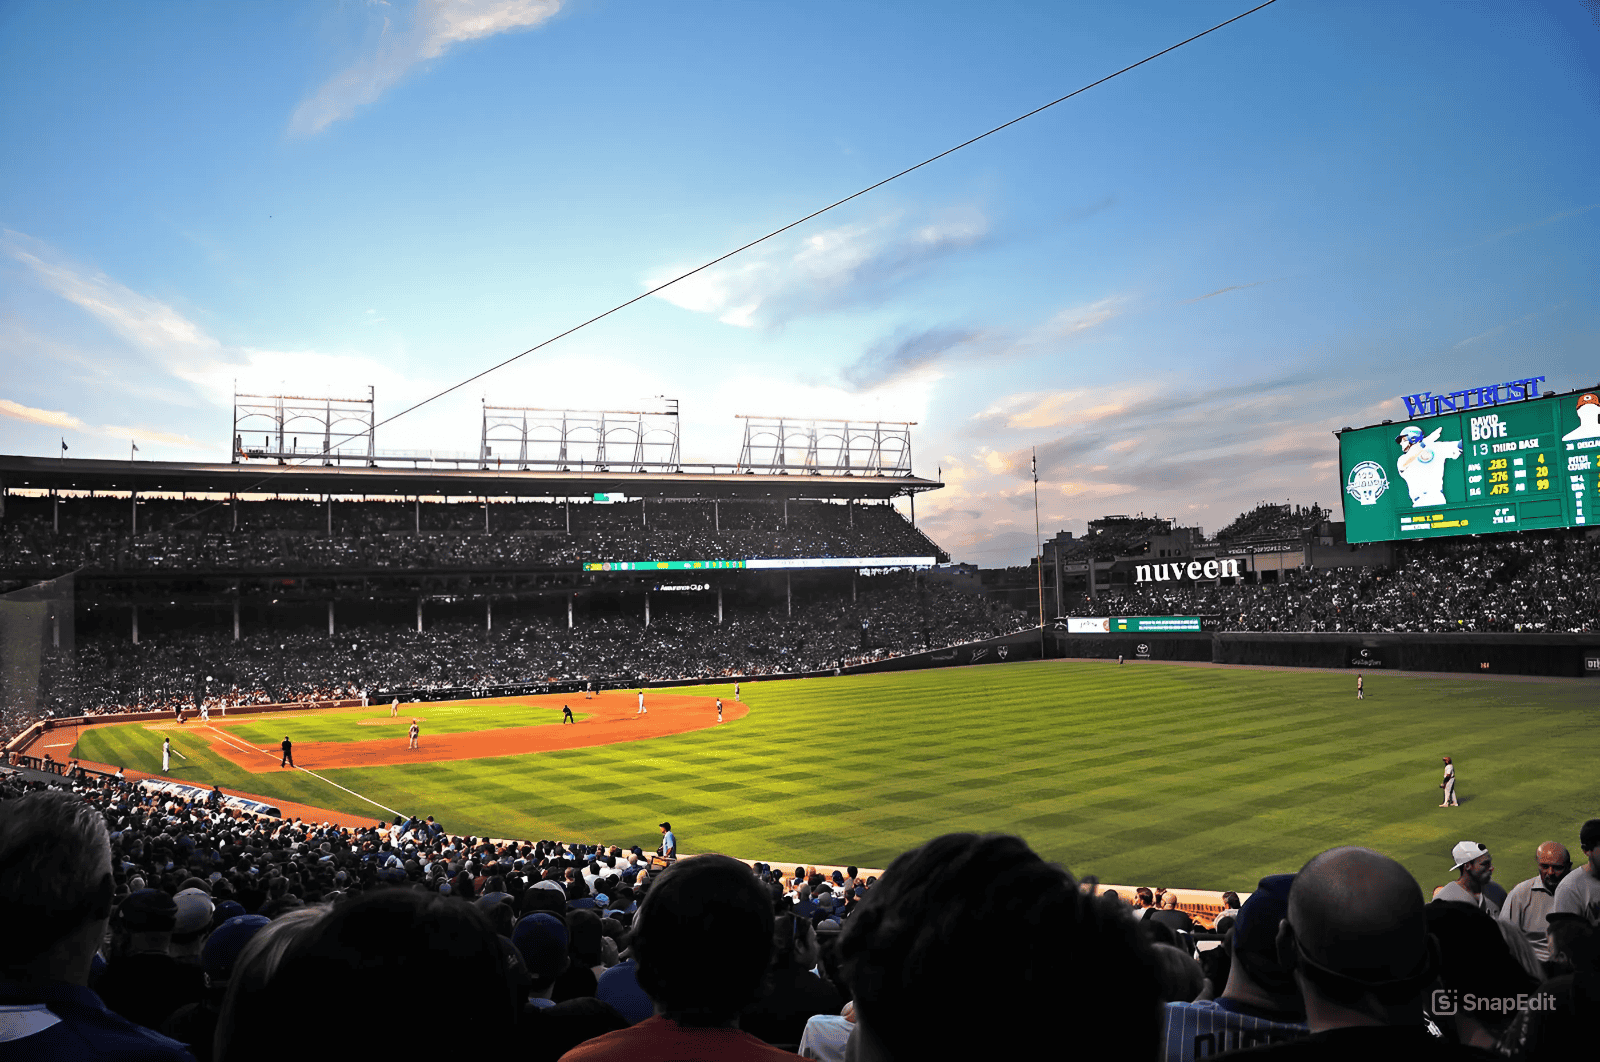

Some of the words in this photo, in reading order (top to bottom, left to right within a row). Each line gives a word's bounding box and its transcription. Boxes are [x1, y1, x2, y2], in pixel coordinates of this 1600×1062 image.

[1401, 376, 1545, 416] WINTRUST
[1471, 414, 1498, 427] DAVID
[1471, 422, 1507, 441] BOTE
[1492, 442, 1517, 453] THIRD
[1519, 438, 1539, 449] BASE
[1536, 466, 1548, 478] 20
[1135, 558, 1240, 583] nuveen
